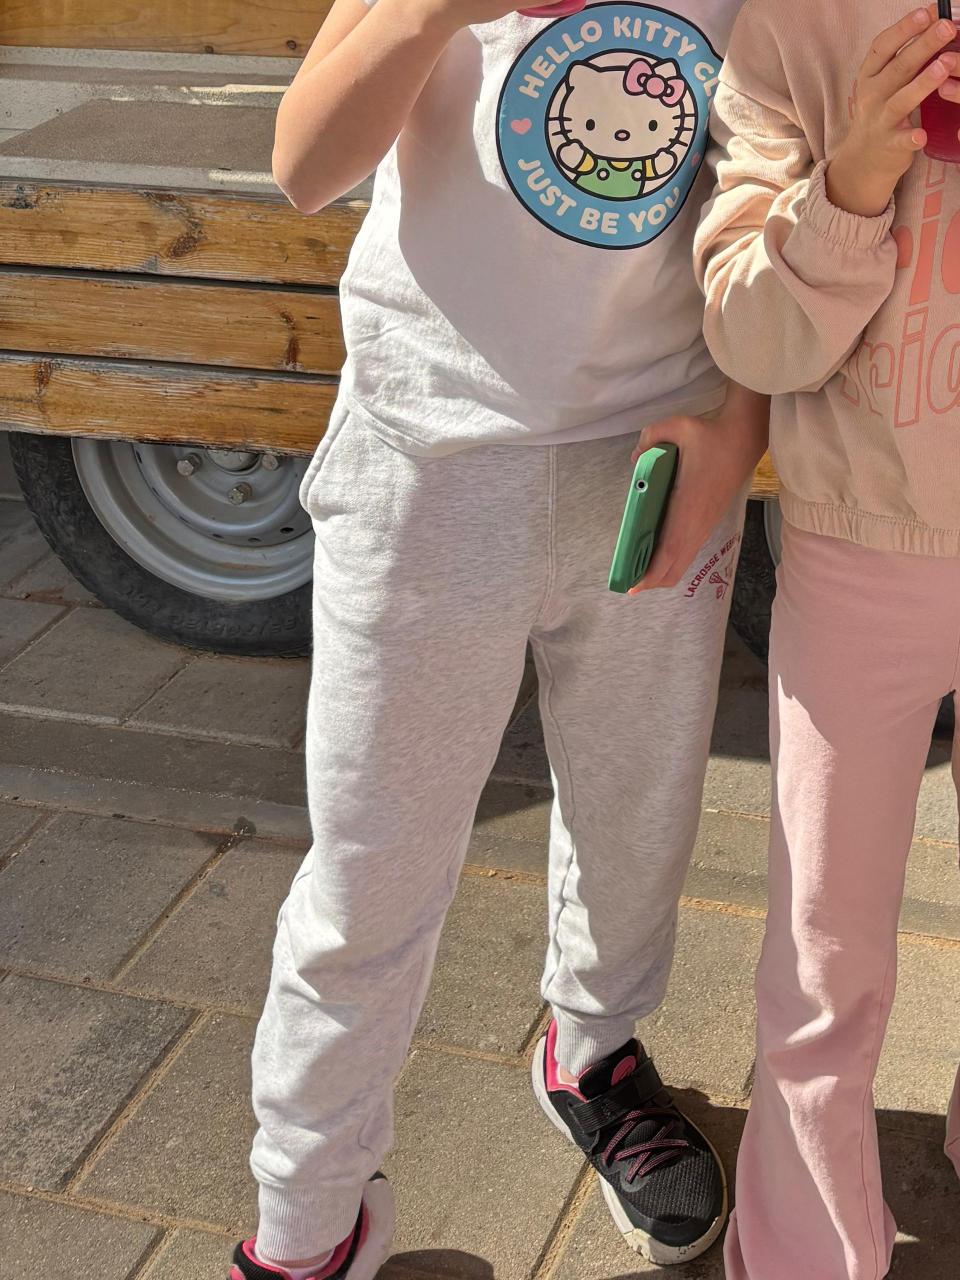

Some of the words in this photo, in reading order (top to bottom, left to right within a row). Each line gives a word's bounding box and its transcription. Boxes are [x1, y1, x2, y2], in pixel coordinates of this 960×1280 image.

[518, 20, 603, 98] HELLO
[613, 16, 697, 57] KITTY
[694, 61, 719, 97] CL
[517, 159, 577, 216] JUST
[579, 207, 620, 235] BE
[628, 186, 680, 232] YOU
[684, 553, 720, 598] LACROSSE
